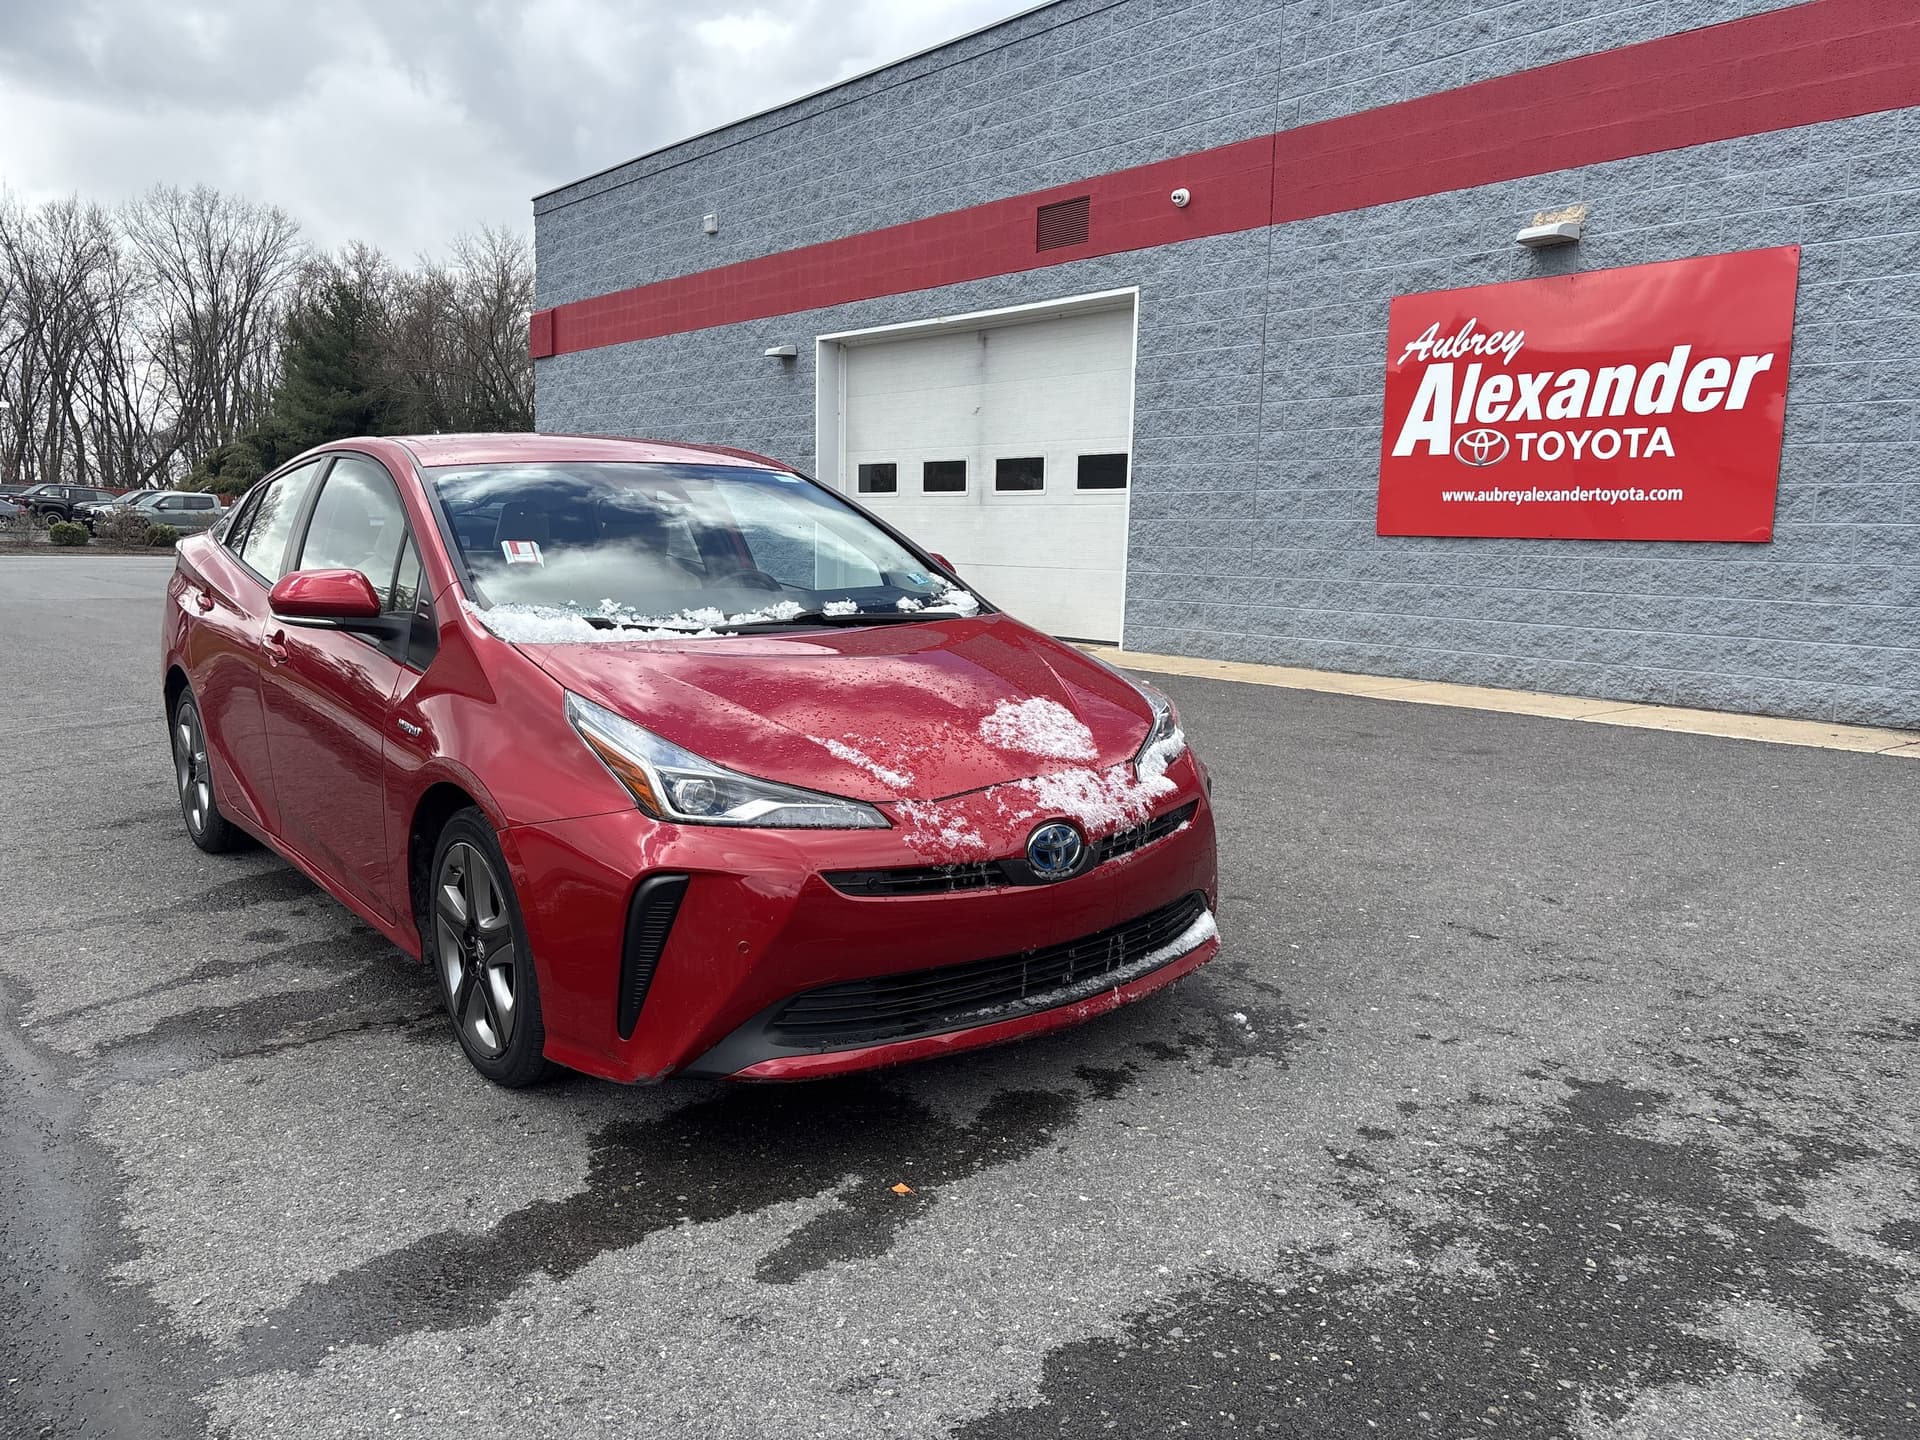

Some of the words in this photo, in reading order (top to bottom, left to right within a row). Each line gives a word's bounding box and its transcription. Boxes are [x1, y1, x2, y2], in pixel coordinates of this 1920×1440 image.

[1397, 317, 1525, 366] Aubrey
[1391, 344, 1775, 457] Alexander
[1515, 426, 1675, 462] TOYOTA
[1442, 486, 1683, 505] www.aubreyalexandertoyota.com
